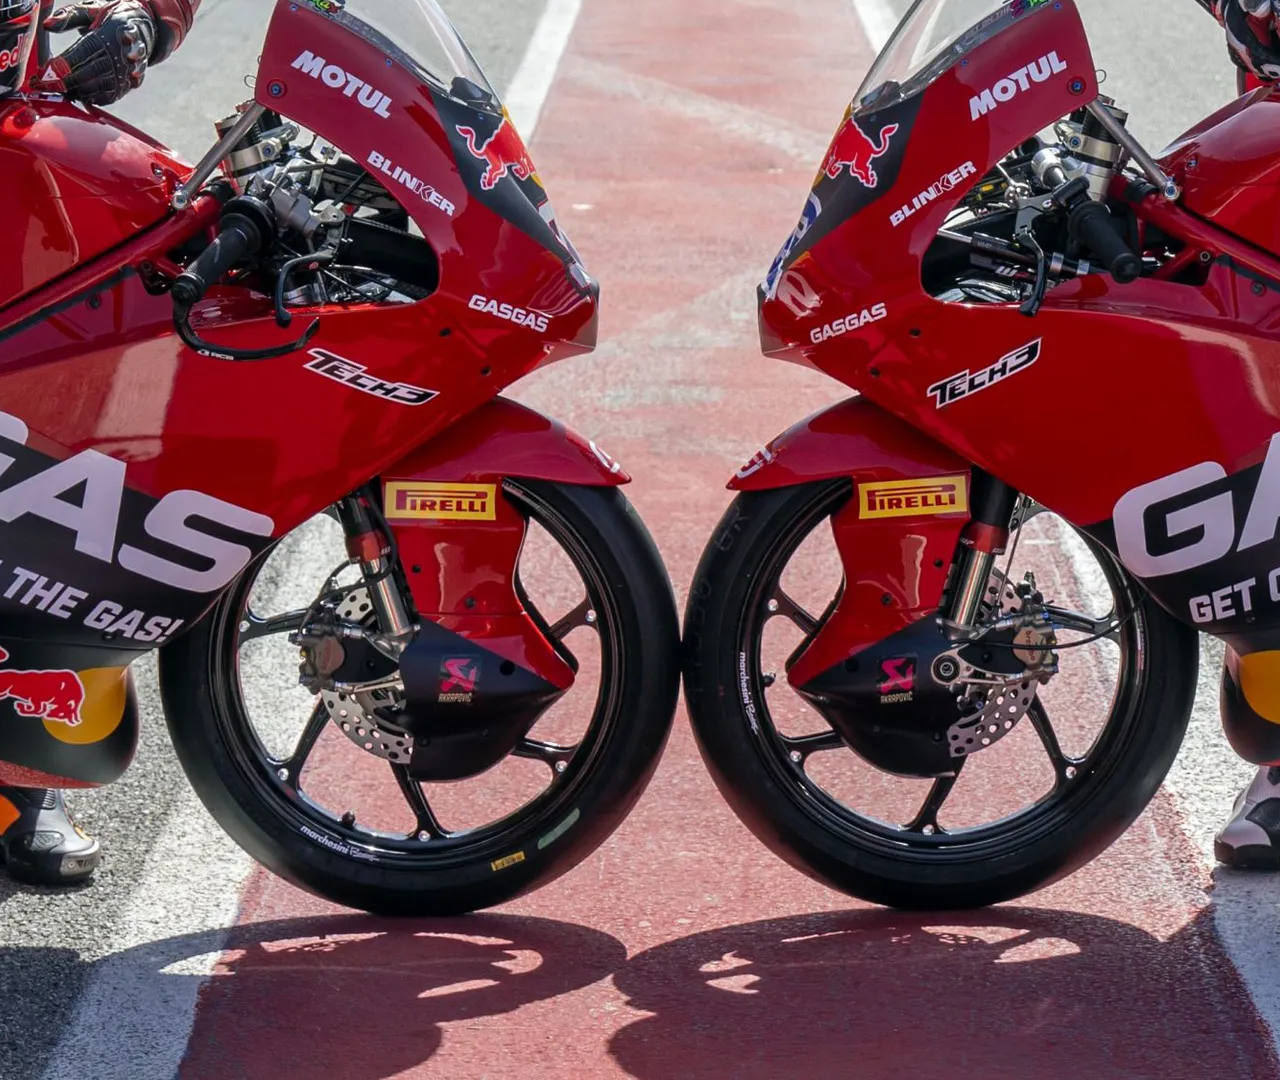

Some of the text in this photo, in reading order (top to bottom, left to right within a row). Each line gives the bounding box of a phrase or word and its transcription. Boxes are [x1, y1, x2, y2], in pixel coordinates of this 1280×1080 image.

[291, 49, 393, 119] MOTUL
[969, 50, 1067, 121] MOTUL
[367, 150, 455, 216] BLINKER
[889, 160, 977, 227] BLINKER
[468, 293, 549, 333] GASGAS
[810, 303, 887, 344] GASGAS
[303, 348, 440, 406] TECH3
[927, 337, 1043, 409] TECH3
[395, 489, 488, 515] PIRELLI
[866, 484, 957, 512] PIRELLI
[8, 565, 90, 620] THE
[83, 599, 185, 644] GAS!
[1188, 577, 1257, 623] GET
[300, 825, 349, 855] marchesini
